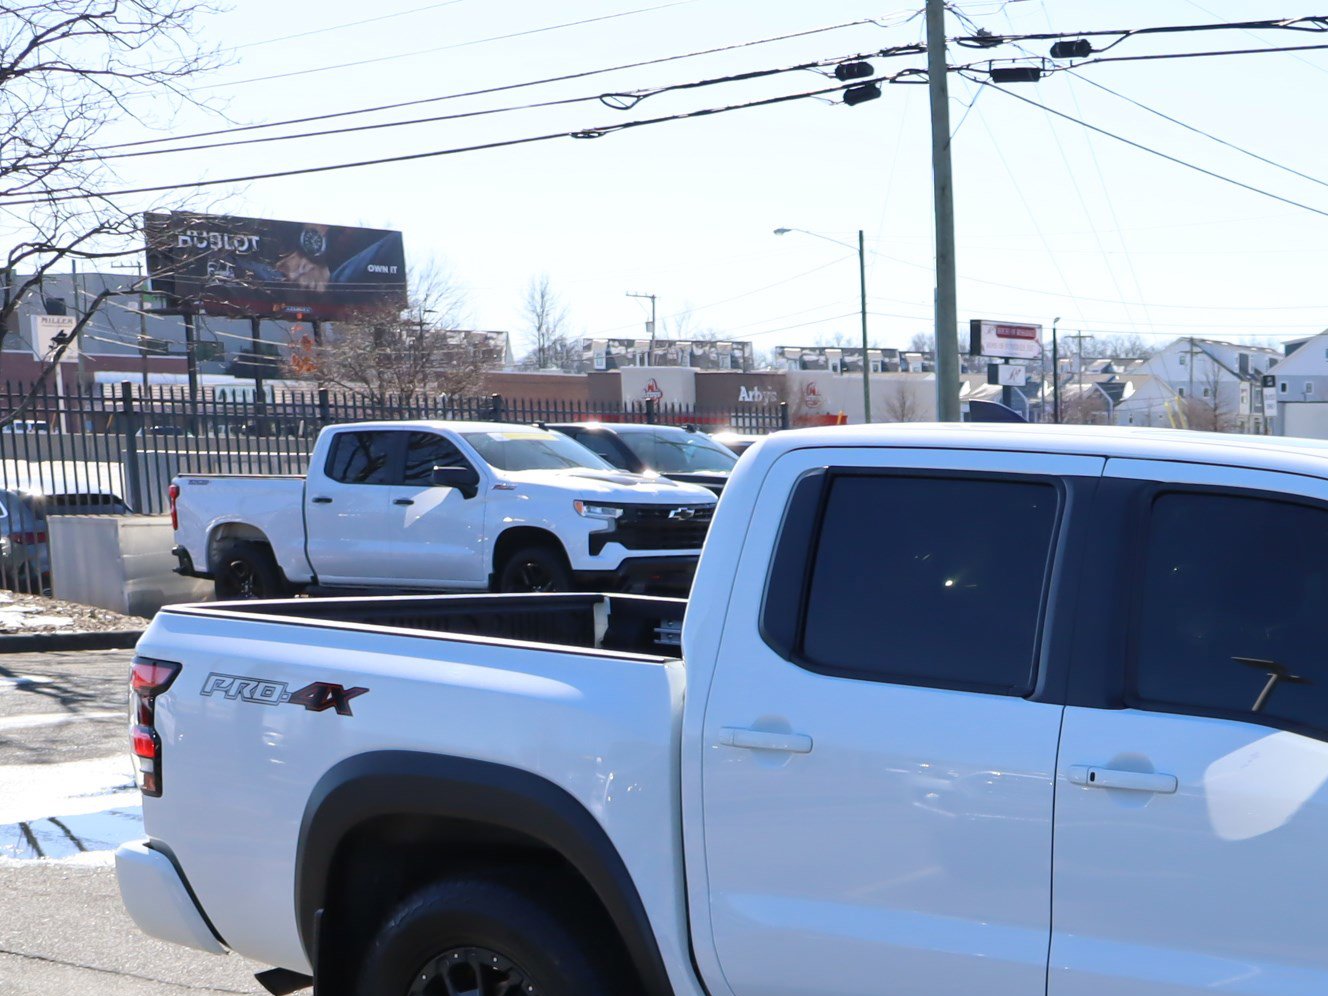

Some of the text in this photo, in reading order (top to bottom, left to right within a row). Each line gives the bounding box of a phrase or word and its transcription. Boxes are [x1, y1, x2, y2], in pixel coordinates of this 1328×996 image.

[367, 264, 398, 275] OWN IT
[738, 385, 778, 406] Arby's
